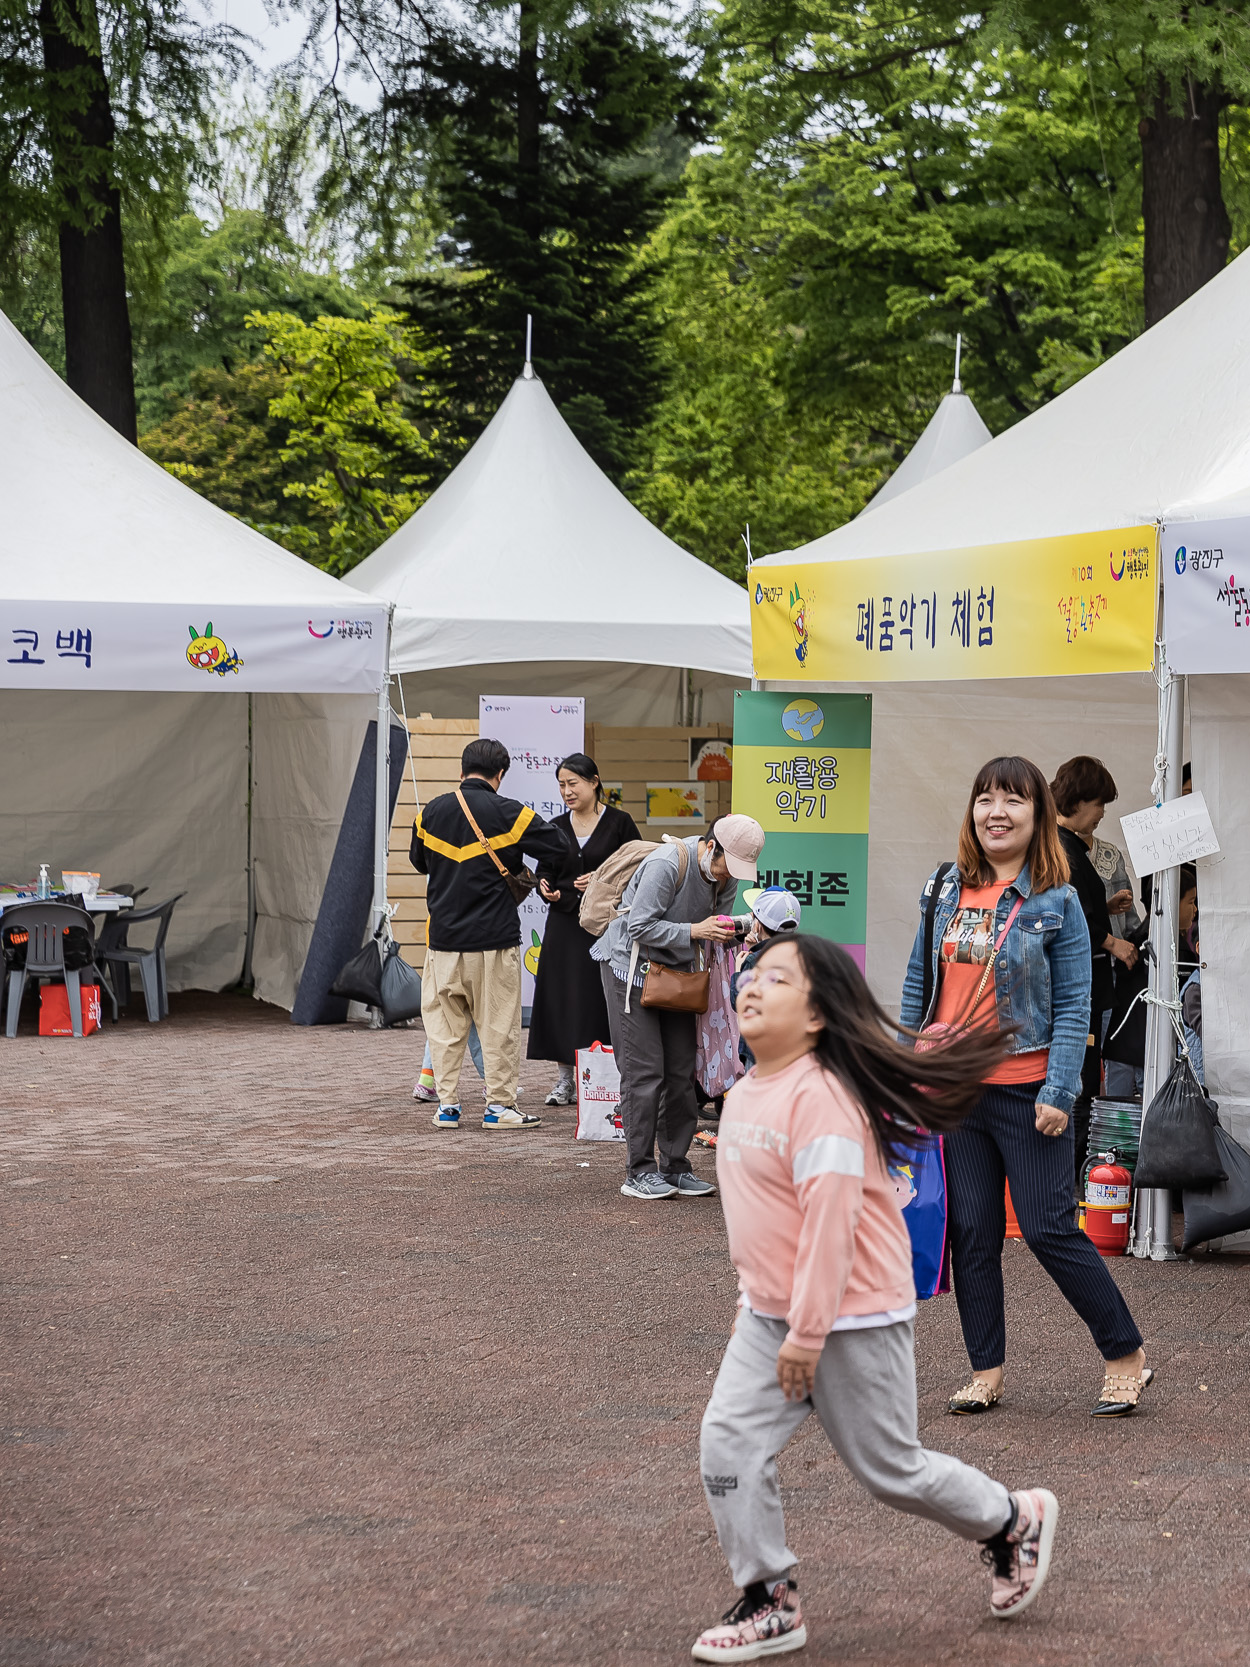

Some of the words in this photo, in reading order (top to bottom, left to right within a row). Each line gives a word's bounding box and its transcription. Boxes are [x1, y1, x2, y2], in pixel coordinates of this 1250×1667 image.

[1190, 549, 1224, 571] 광진구
[856, 591, 937, 652] 폐품악기
[950, 585, 994, 648] 체험
[511, 752, 567, 769] 서울동화축
[765, 756, 839, 790] 재활용
[776, 791, 826, 822] 악기
[943, 926, 994, 945] Califoia
